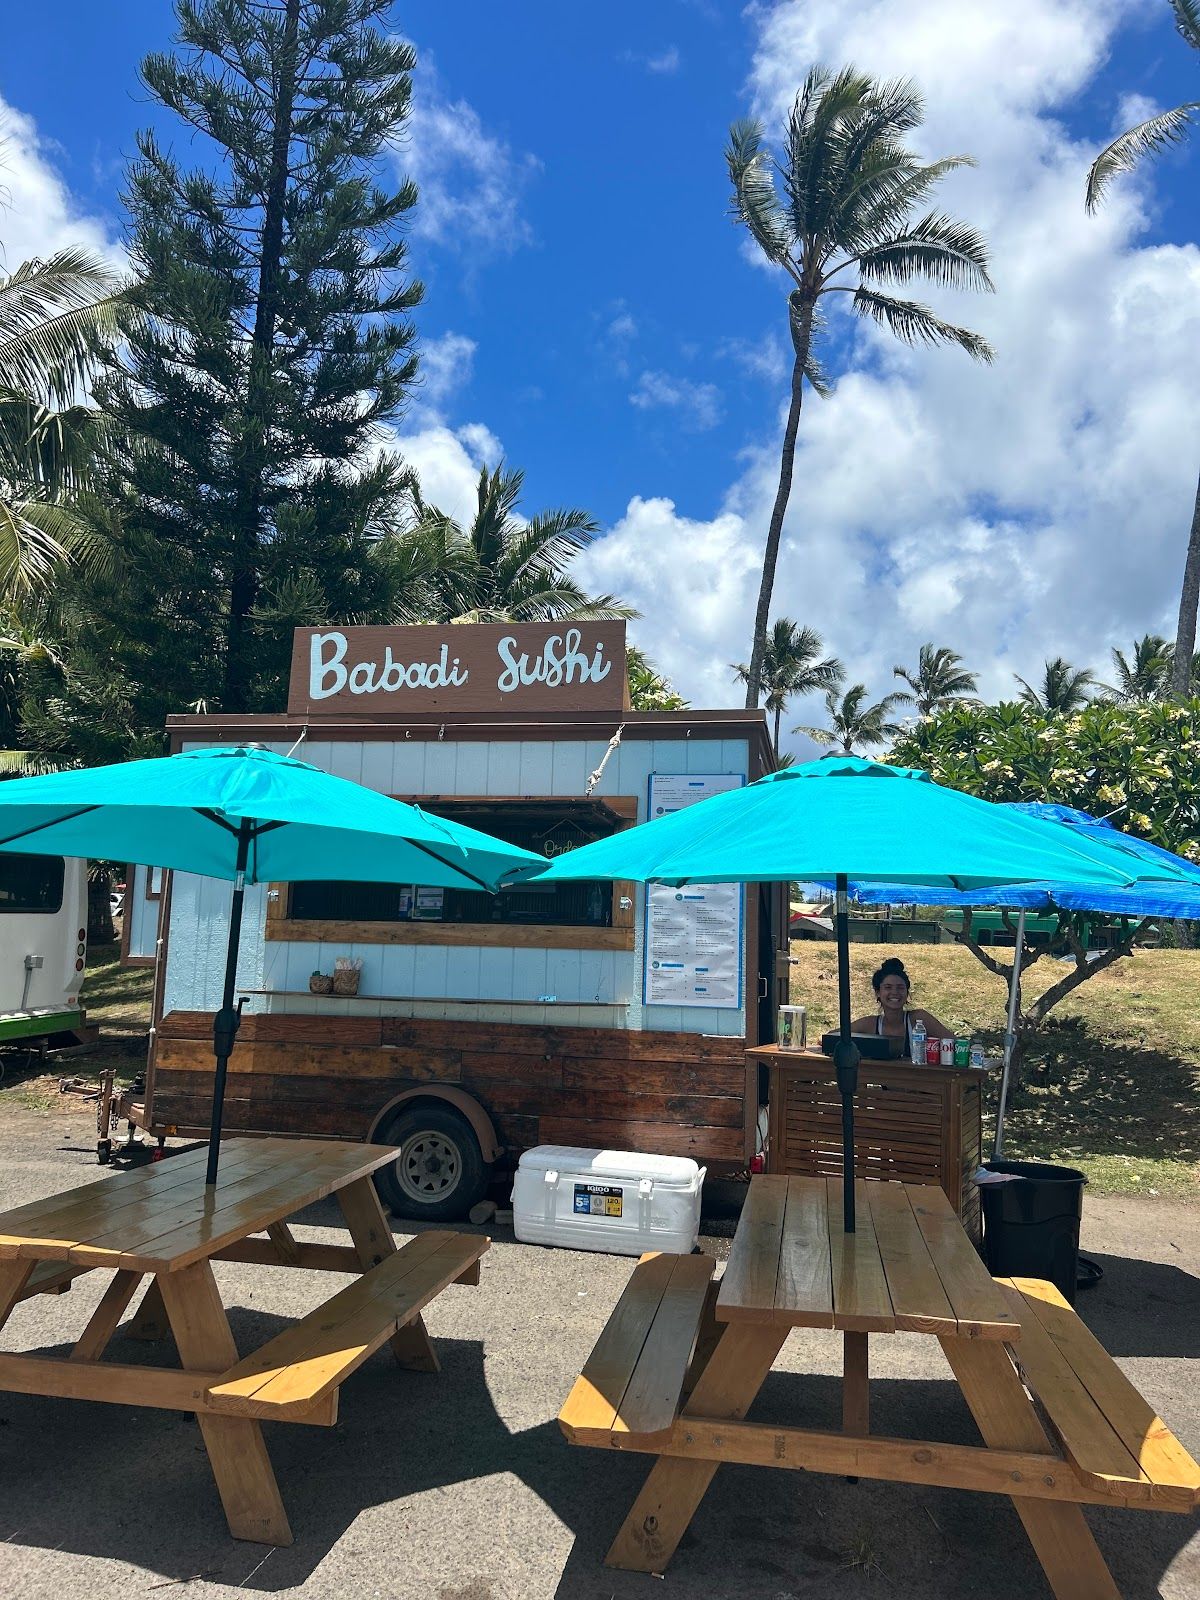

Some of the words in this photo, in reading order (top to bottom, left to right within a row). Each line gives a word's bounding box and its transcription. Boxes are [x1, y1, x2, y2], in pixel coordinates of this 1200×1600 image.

[310, 631, 468, 700] Babadi
[498, 628, 611, 693] Sushi
[576, 1197, 584, 1207] 5
